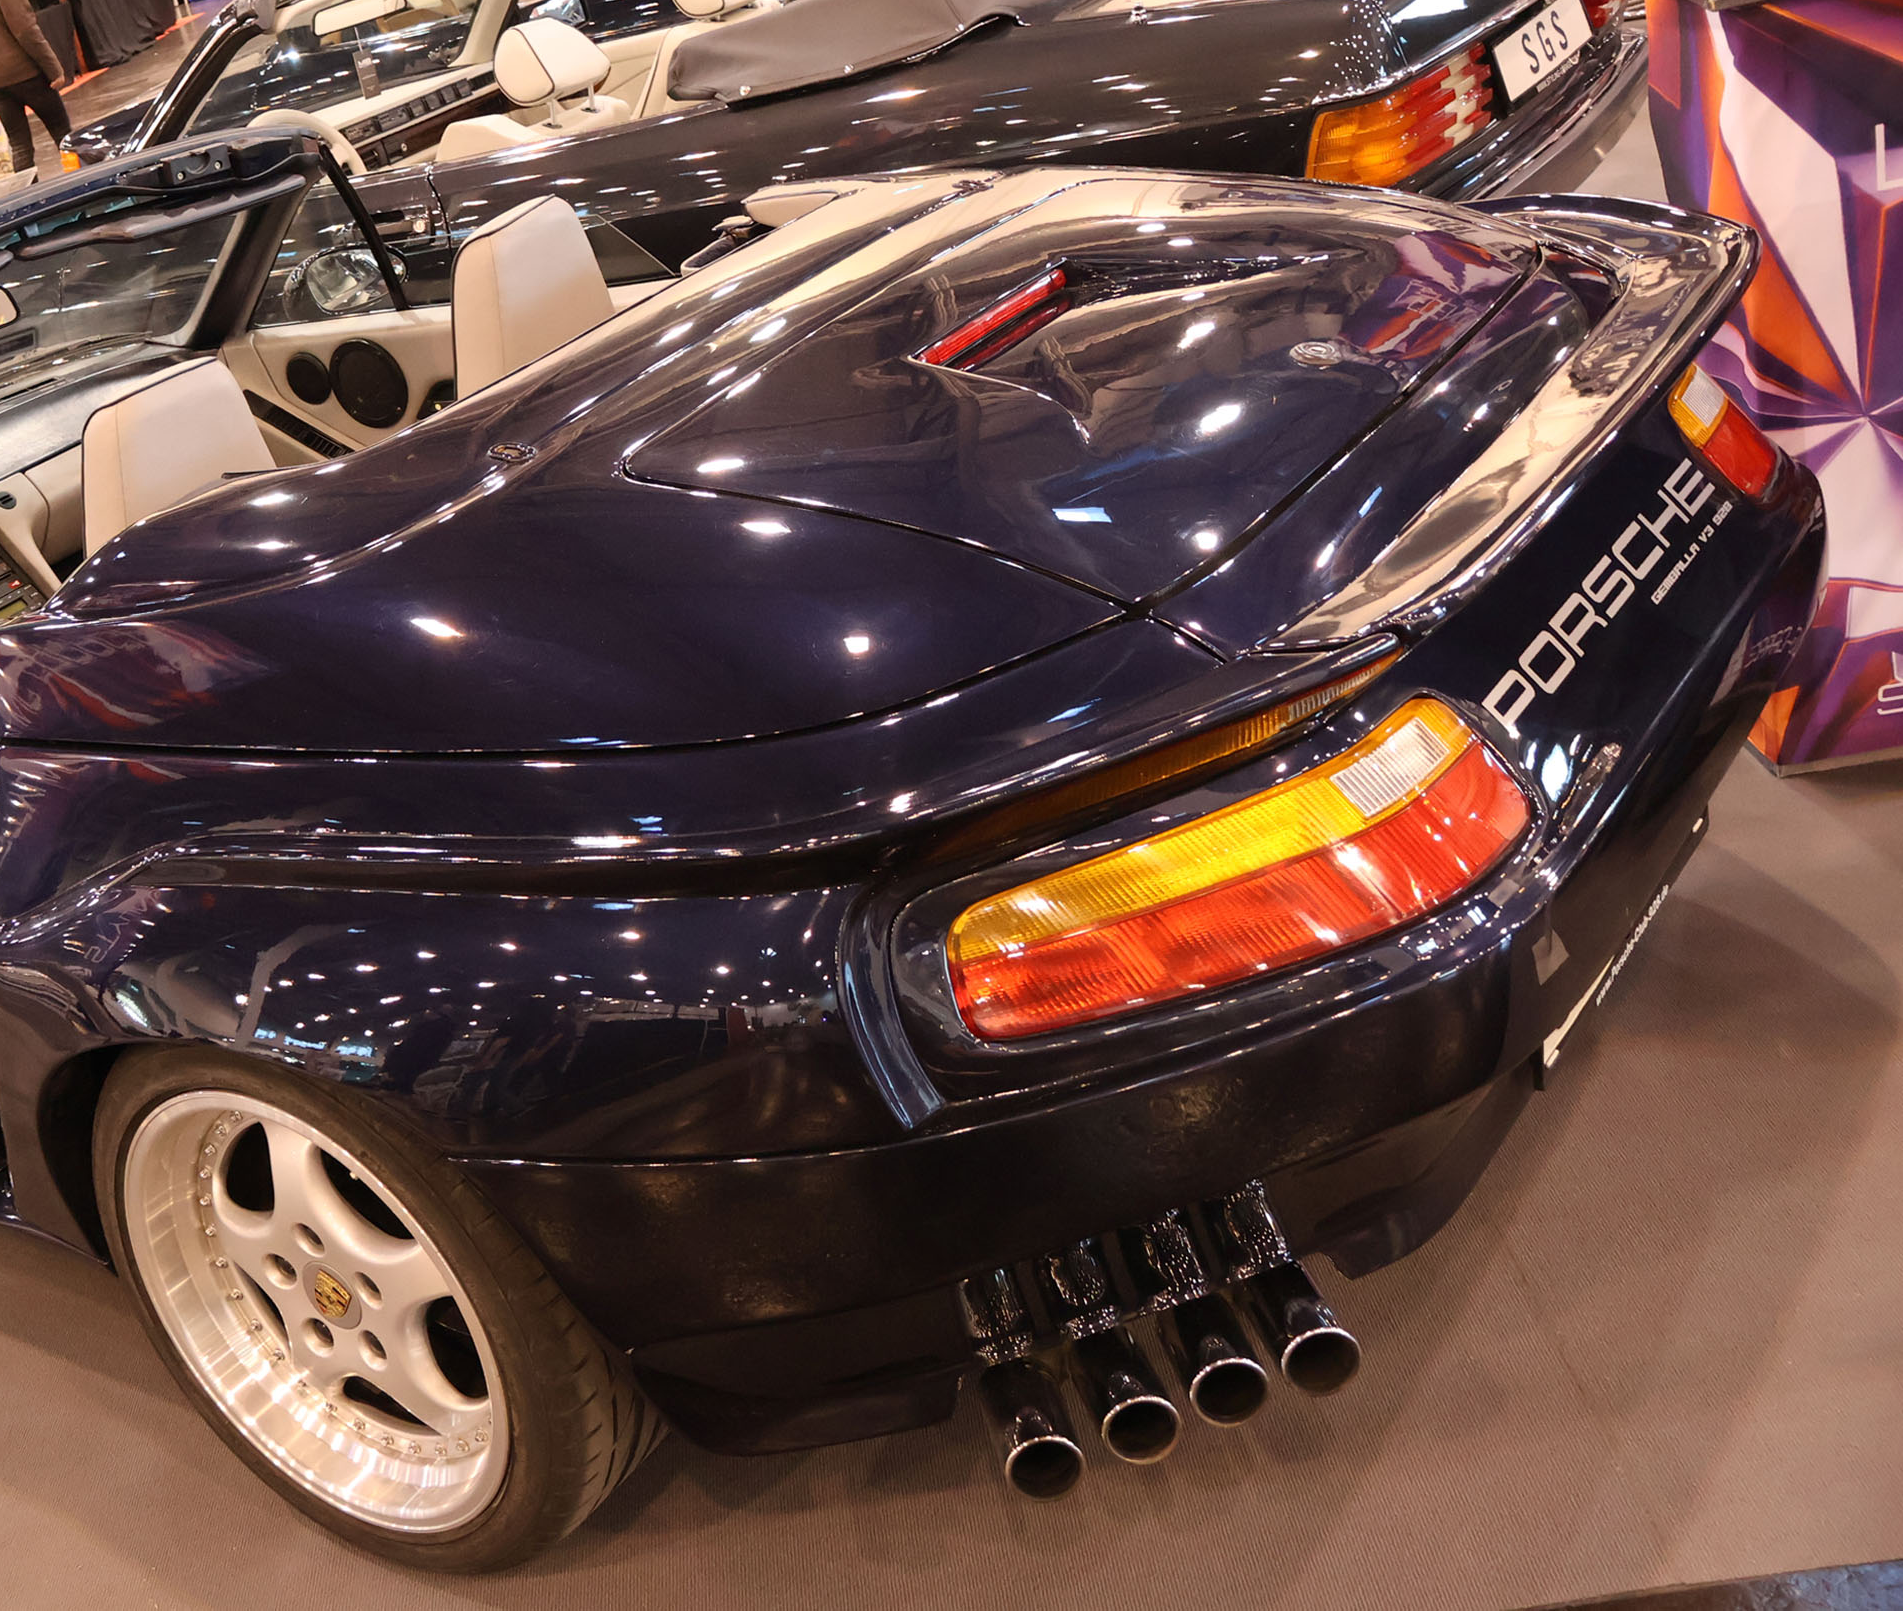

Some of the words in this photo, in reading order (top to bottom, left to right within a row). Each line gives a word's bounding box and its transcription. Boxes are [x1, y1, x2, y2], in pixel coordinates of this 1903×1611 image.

[1521, 10, 1568, 74] SGS
[1481, 457, 1716, 739] PORSCHE
[1651, 542, 1701, 605] GEMBALLA
[1698, 524, 1715, 543] V3
[1712, 500, 1734, 526] 928
